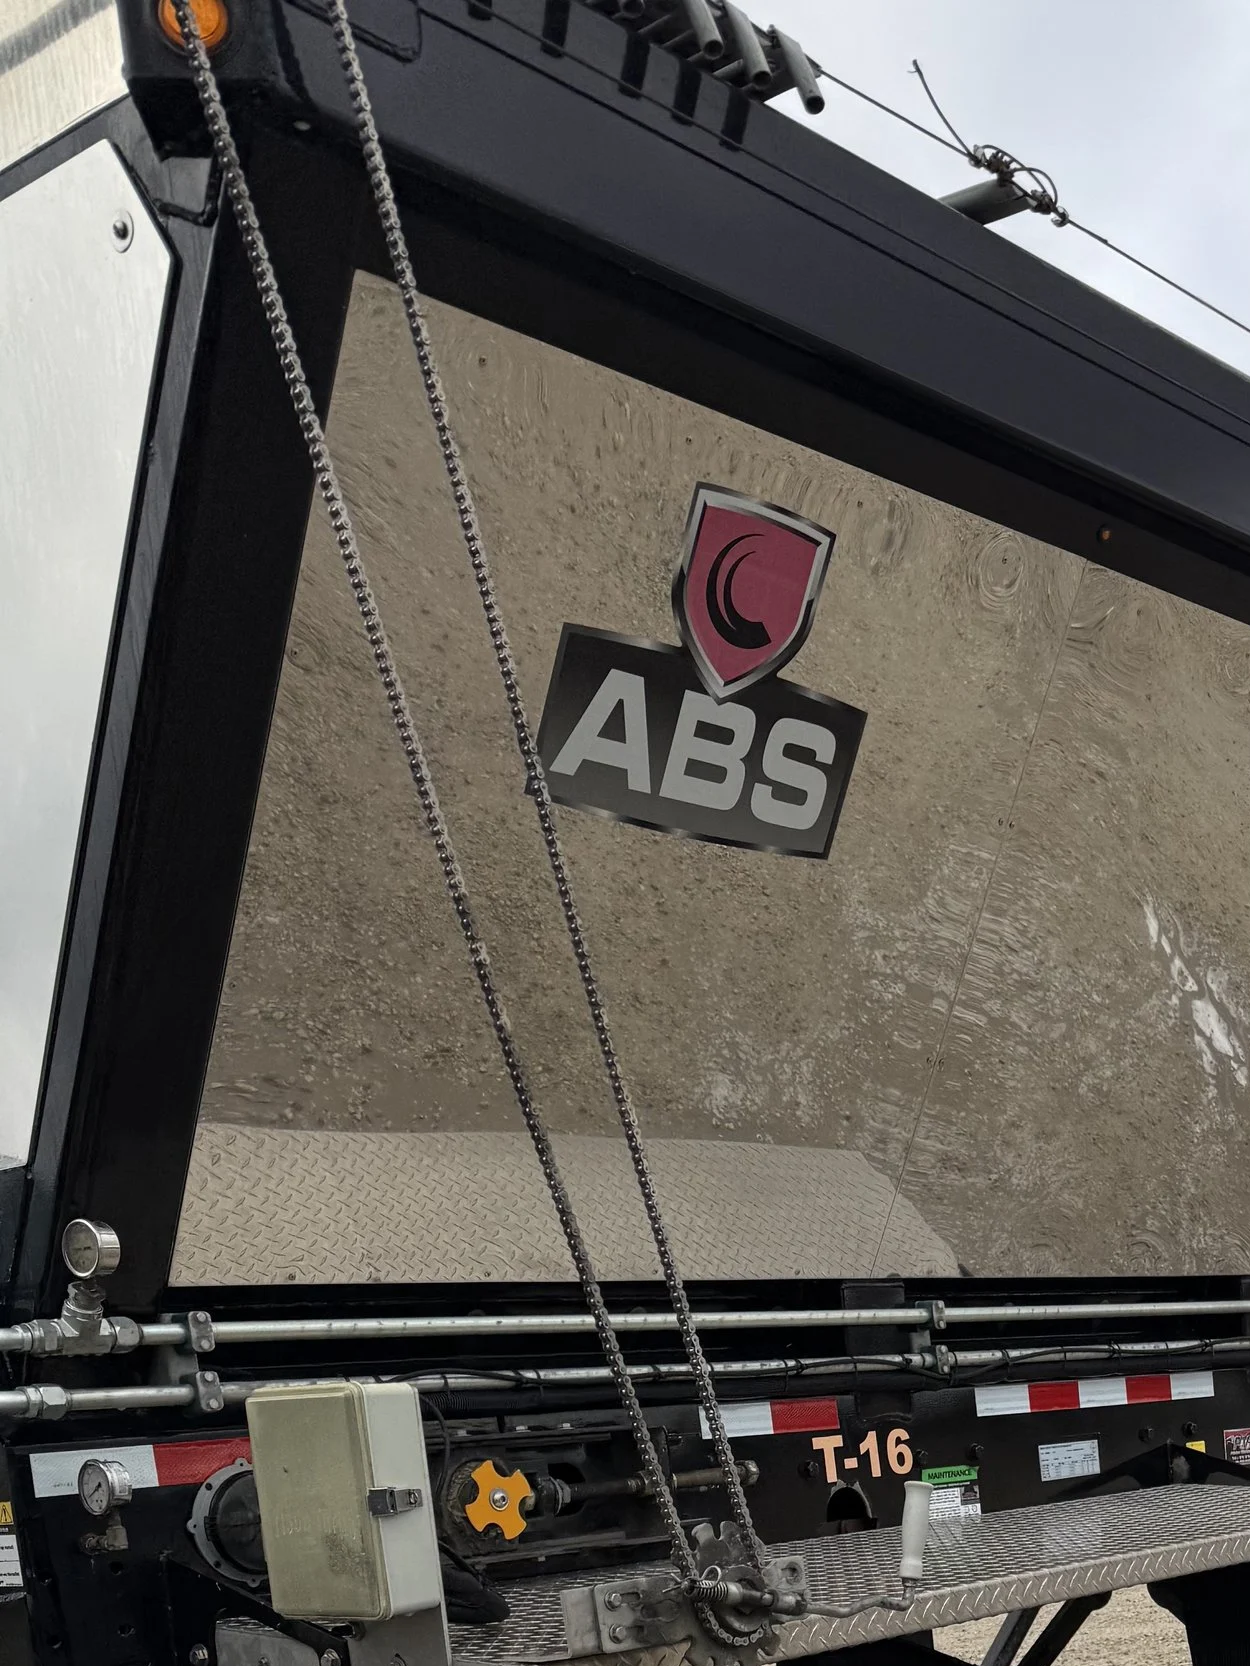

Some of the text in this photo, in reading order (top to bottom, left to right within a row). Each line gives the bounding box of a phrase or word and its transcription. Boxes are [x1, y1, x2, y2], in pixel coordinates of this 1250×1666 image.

[549, 668, 837, 830] ABS
[811, 1428, 913, 1483] T-16
[927, 1468, 973, 1481] MAINTENANCE
